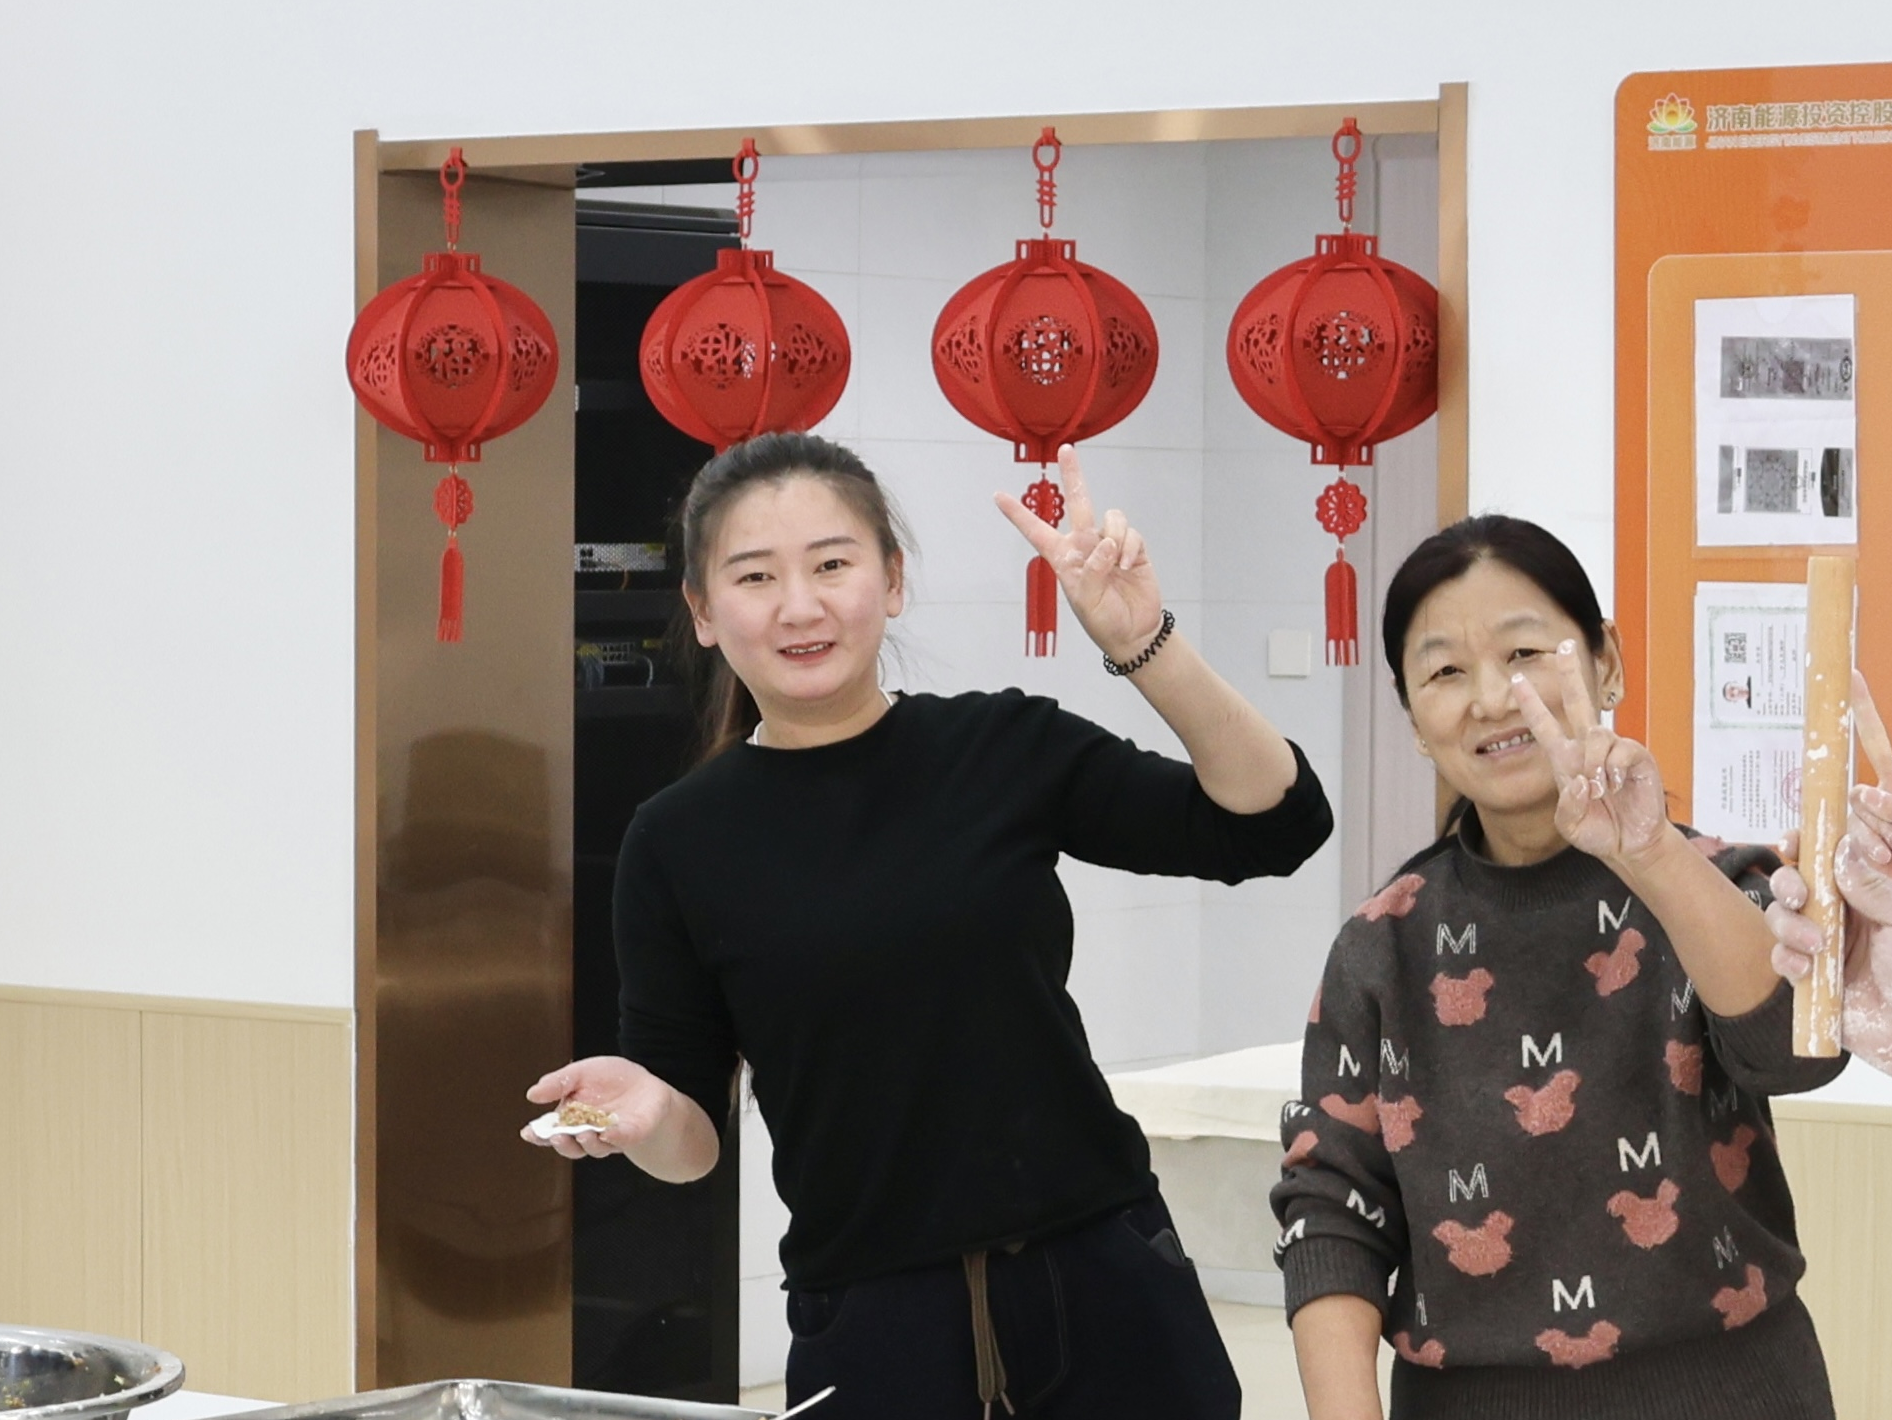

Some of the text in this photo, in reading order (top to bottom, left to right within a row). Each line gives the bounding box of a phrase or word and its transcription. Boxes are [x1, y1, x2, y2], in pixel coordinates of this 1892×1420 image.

[1436, 922, 1476, 955] M
[1521, 1032, 1563, 1068] M
[1617, 1131, 1662, 1172] M
[1449, 1163, 1489, 1203] M
[1552, 1274, 1596, 1312] M
